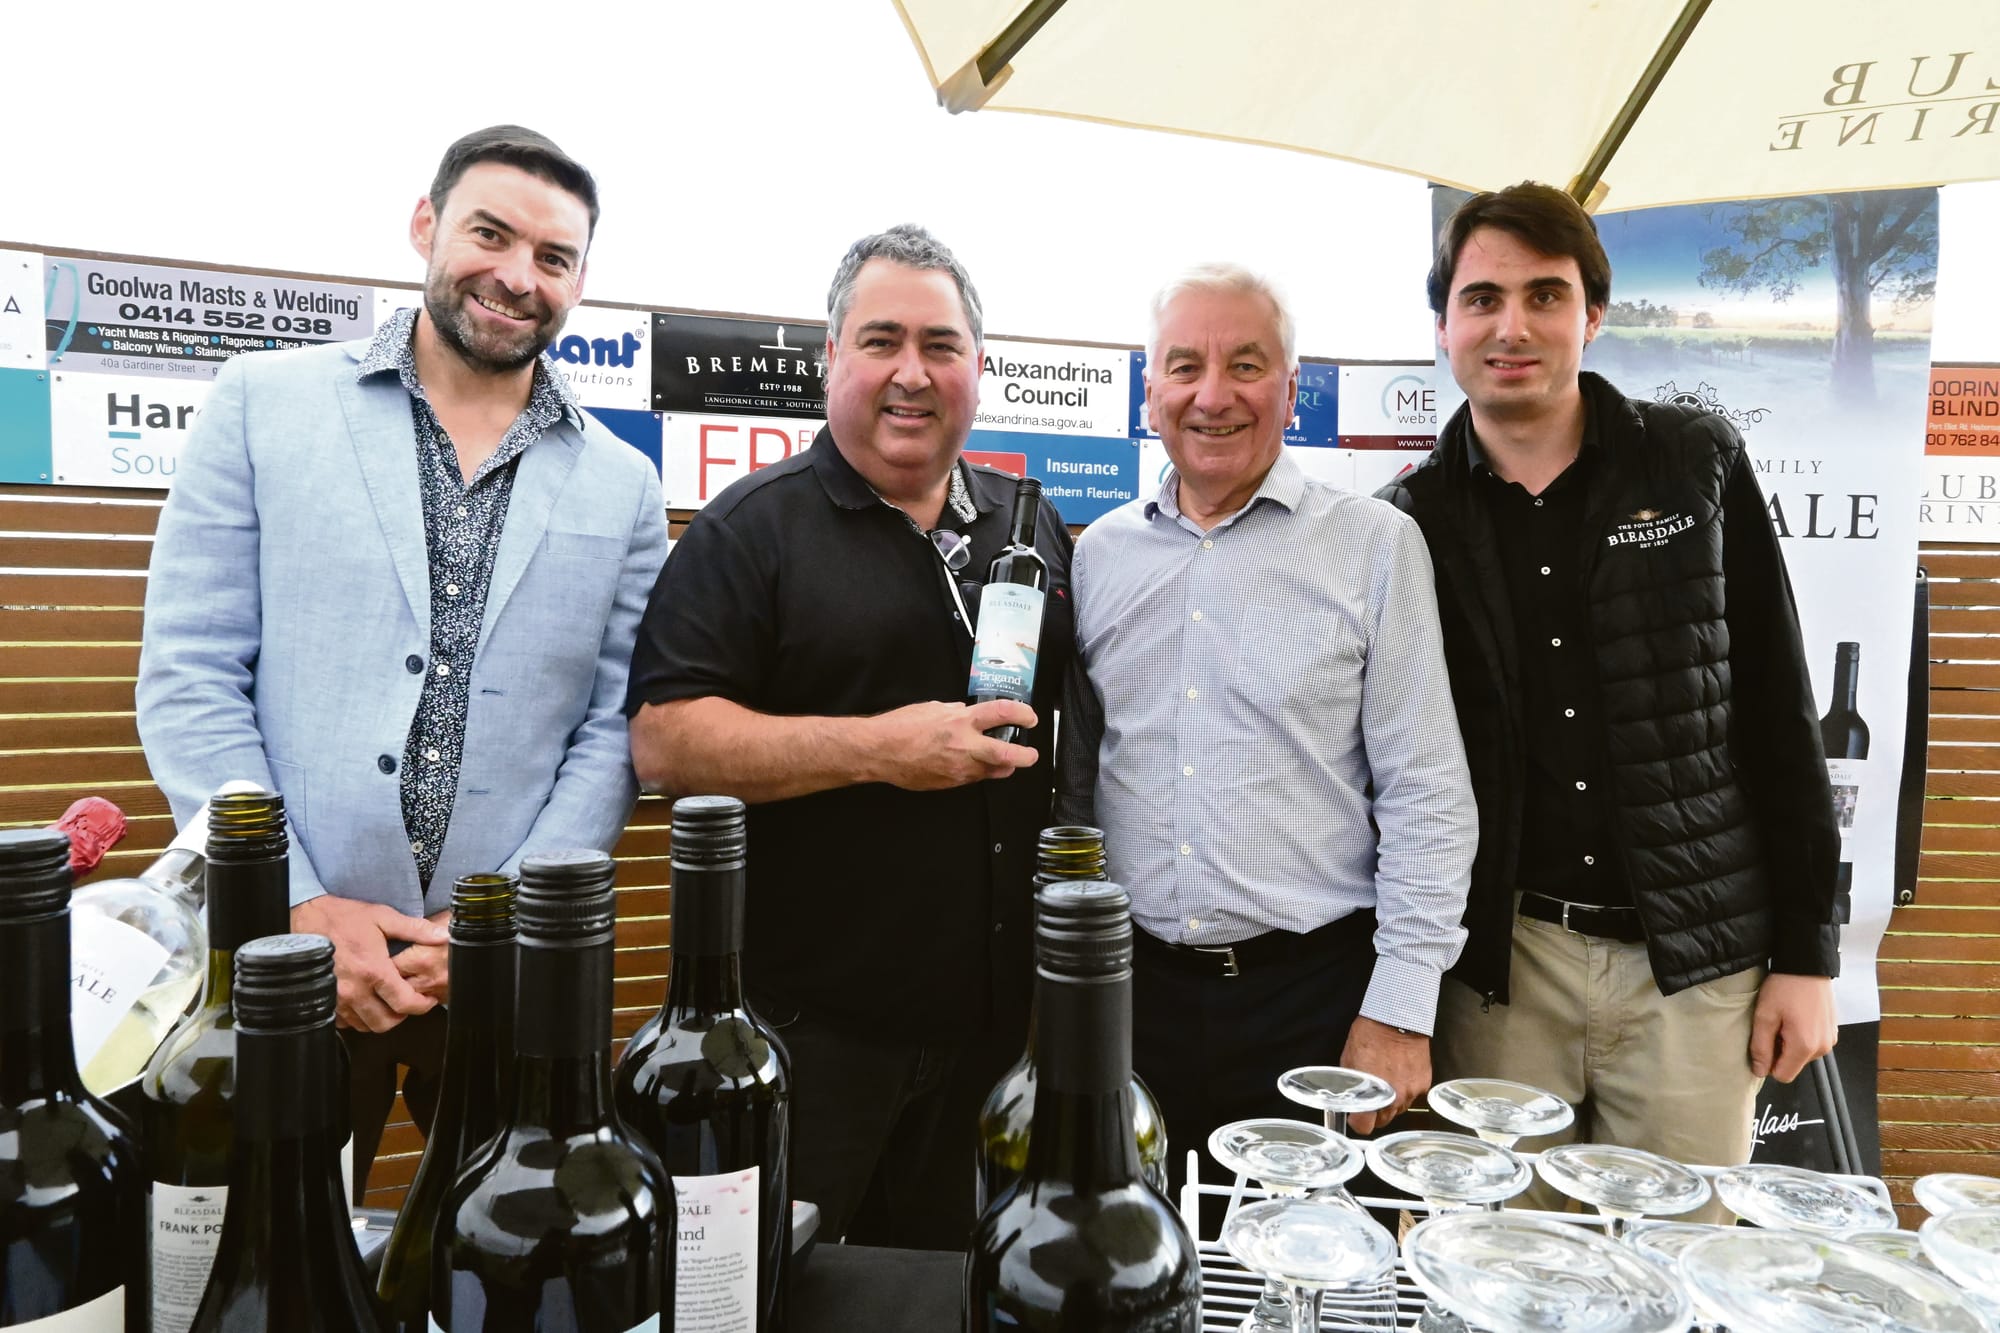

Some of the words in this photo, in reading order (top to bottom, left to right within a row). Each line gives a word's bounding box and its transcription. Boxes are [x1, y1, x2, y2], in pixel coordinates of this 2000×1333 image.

[87, 272, 173, 301] Goolwa
[180, 280, 246, 307] Masts
[253, 291, 266, 309] &
[273, 288, 358, 320] Welding
[119, 303, 195, 325] 0414
[203, 310, 265, 330] 552
[272, 315, 332, 335] 038
[98, 326, 126, 338] Yacht
[129, 328, 159, 340] Masts
[162, 331, 170, 341] &
[172, 332, 209, 346] Rigging
[221, 335, 264, 348] Flagpoles
[113, 341, 152, 353] Balcony
[155, 344, 183, 355] Wires
[195, 346, 238, 358] Stainless
[101, 359, 119, 368] 40a
[123, 360, 164, 371] Gardiner
[168, 362, 196, 373] Street
[983, 355, 1112, 384] Alexandrina
[783, 384, 802, 393] 1988
[1004, 383, 1088, 407] Council
[704, 396, 752, 406] LANGHORNE
[754, 399, 778, 407] CREEK
[786, 401, 811, 409] SOUTH
[1398, 413, 1426, 424] web
[1949, 434, 1976, 446] 762
[1046, 458, 1119, 476] Insurance
[1087, 487, 1131, 500] Fleurieu
[1656, 513, 1679, 526] FAMILY
[1608, 515, 1695, 546] BLEASDALE
[980, 671, 1022, 686] Brigand
[160, 1221, 199, 1235] FRANK
